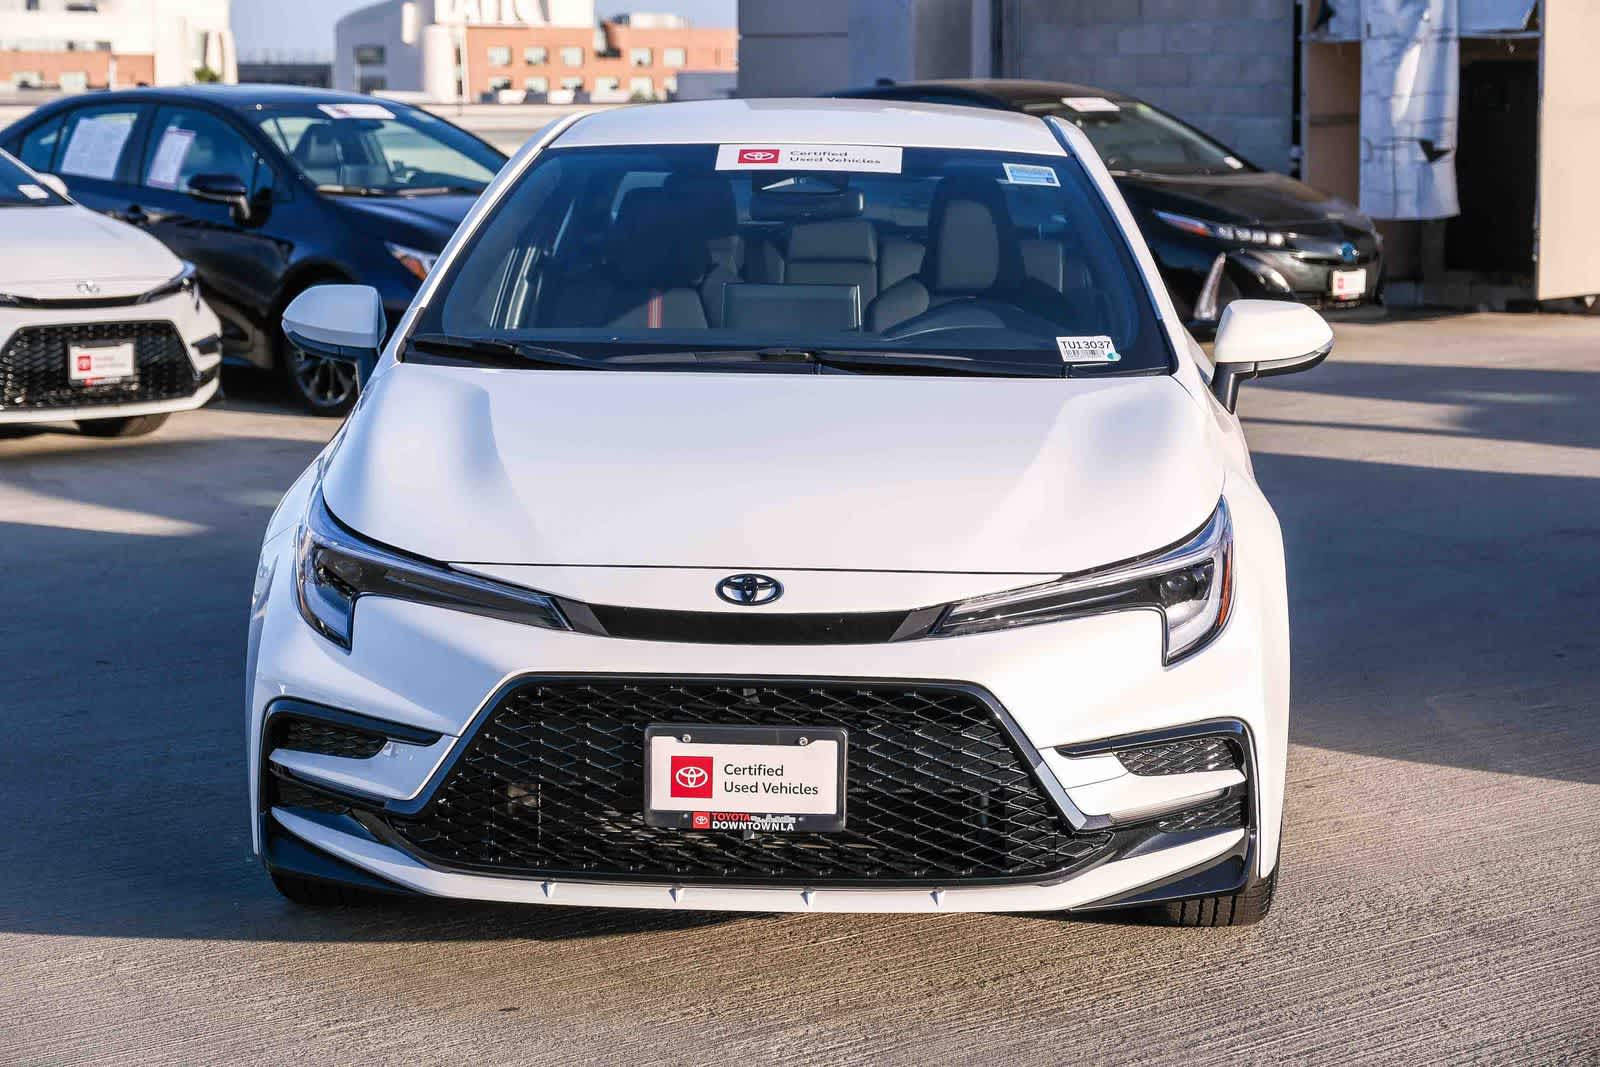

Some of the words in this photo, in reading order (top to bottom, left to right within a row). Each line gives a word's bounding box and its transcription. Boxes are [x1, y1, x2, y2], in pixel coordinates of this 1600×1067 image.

[1061, 340, 1110, 349] TU13037
[724, 763, 784, 777] Certified
[724, 780, 758, 793] Used
[762, 781, 819, 795] Vehicles
[712, 813, 751, 821] TOYOTA
